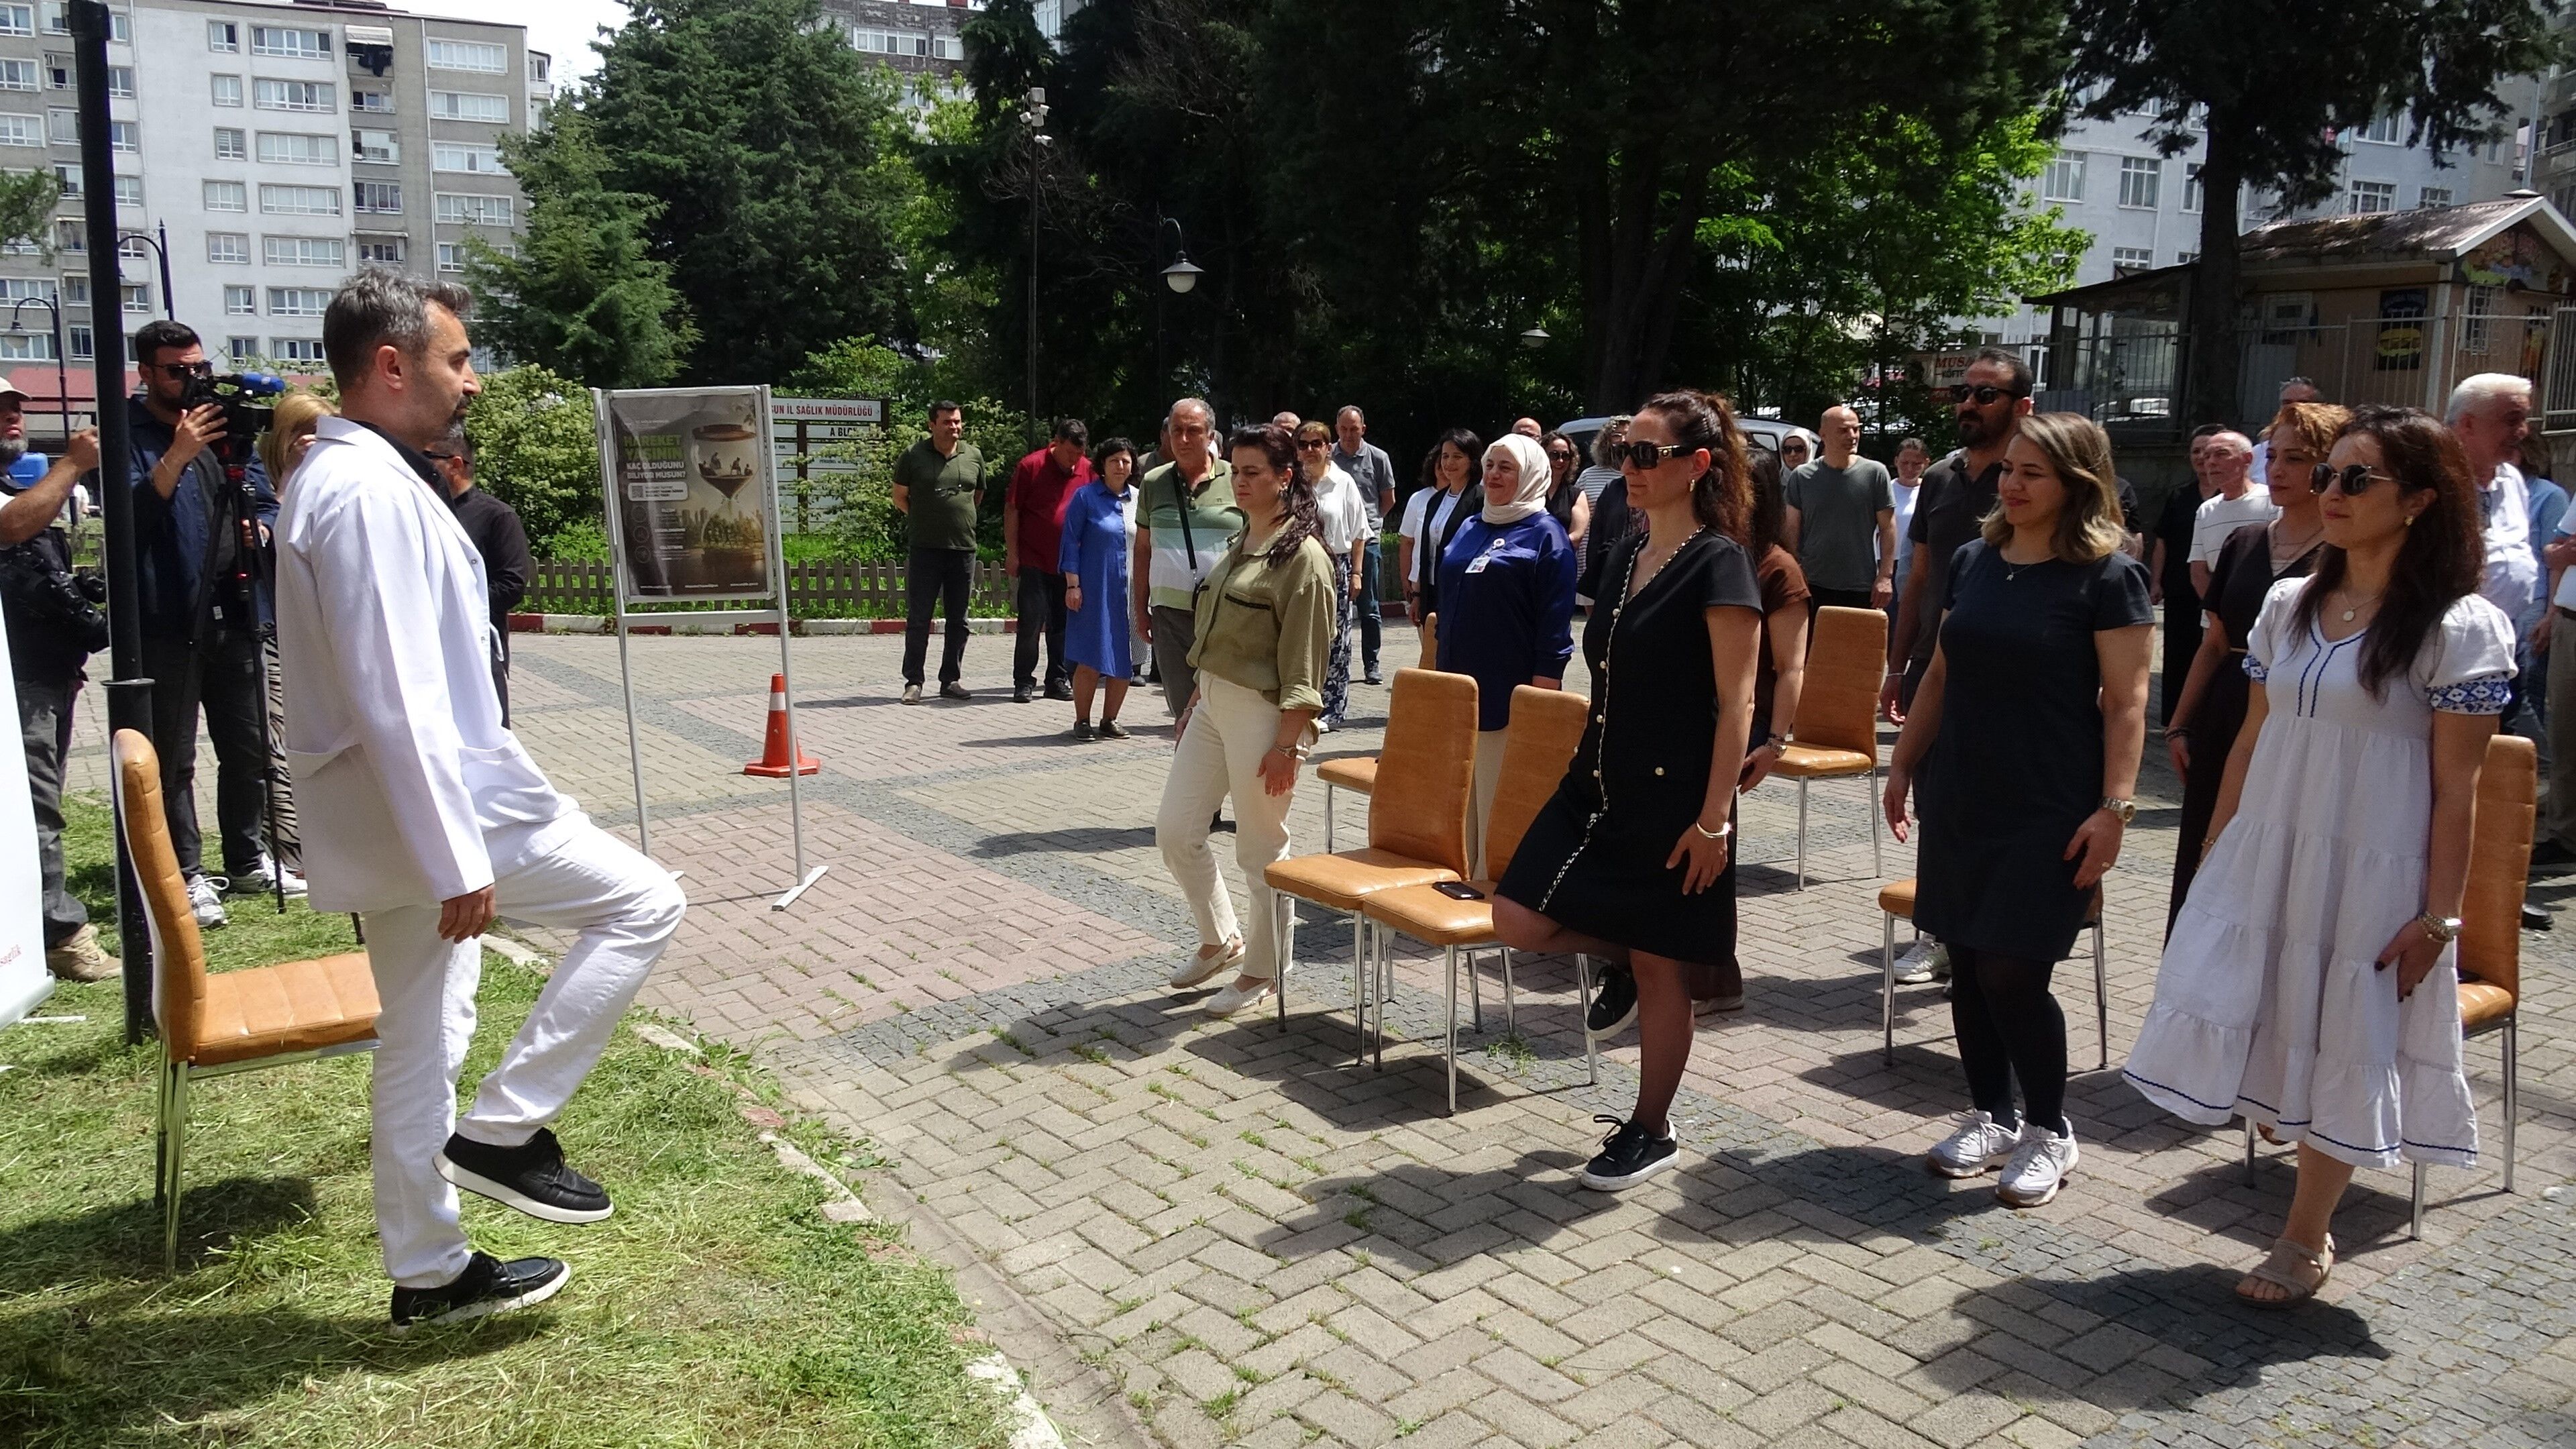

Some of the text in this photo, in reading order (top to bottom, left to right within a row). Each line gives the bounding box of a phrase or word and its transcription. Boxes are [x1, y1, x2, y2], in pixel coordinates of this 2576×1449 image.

[787, 403, 794, 415] İL
[796, 404, 823, 415] SAĞLIK
[825, 404, 873, 417] MÜDÜRLÜĞÜ
[830, 427, 835, 437] A
[623, 434, 682, 447] HAREKET
[626, 460, 684, 471] KAÇ OLDUĞUNU
[655, 470, 686, 479] MUSUN?
